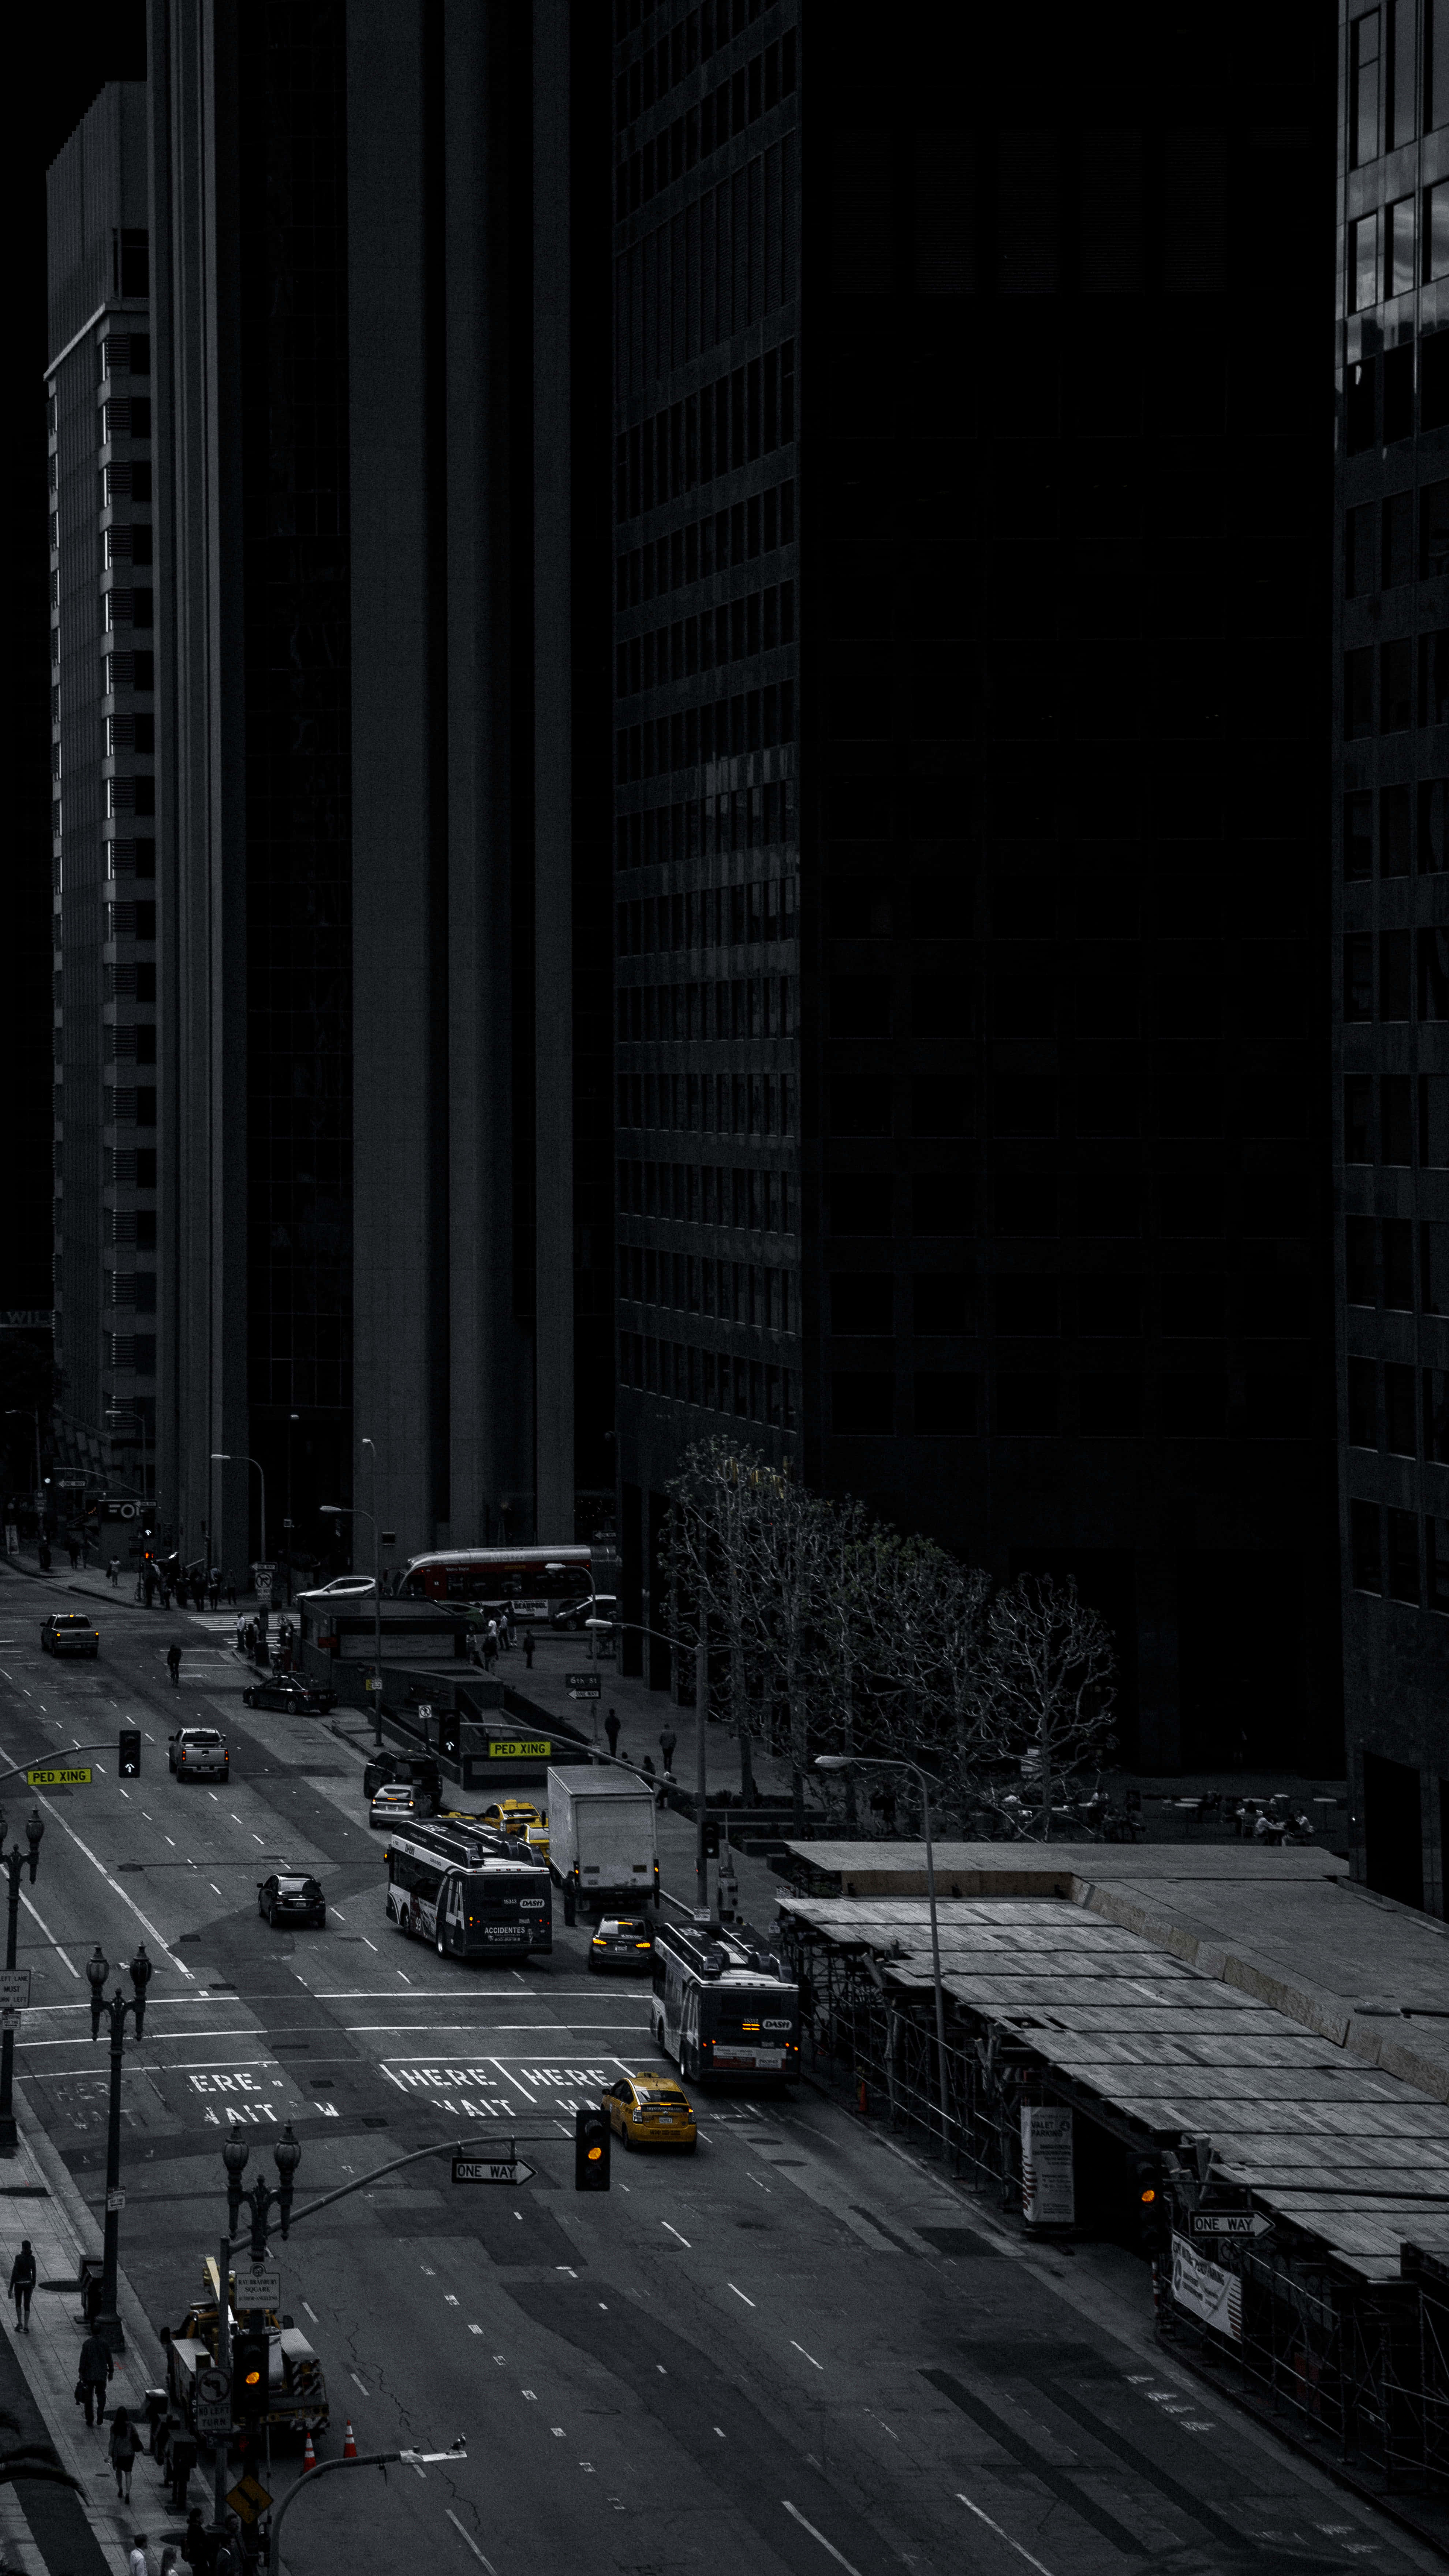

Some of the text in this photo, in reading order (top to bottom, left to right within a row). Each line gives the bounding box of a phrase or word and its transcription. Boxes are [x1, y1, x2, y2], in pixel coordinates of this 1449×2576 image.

[495, 1744, 545, 1754] PED XING
[33, 1771, 86, 1782] PED XING
[399, 2069, 498, 2086] HERE
[520, 2069, 617, 2086] HERE
[458, 2165, 515, 2178] ONE WAY
[1195, 2218, 1253, 2231] ONE WAY
[199, 2406, 230, 2416] NO LEFT
[202, 2418, 226, 2426] TURN
